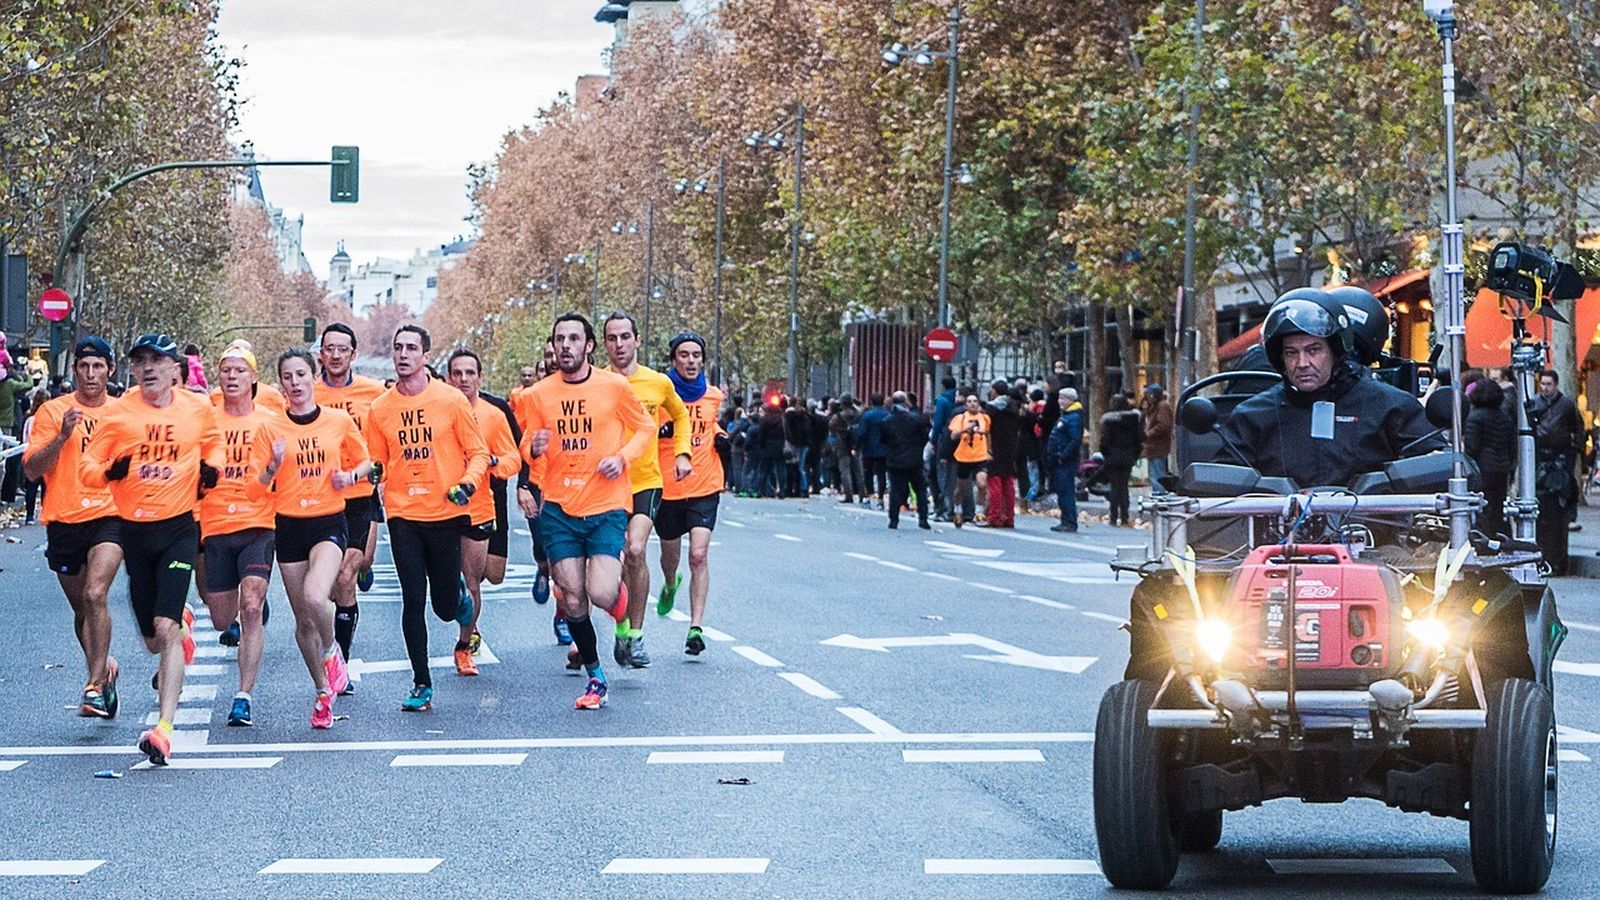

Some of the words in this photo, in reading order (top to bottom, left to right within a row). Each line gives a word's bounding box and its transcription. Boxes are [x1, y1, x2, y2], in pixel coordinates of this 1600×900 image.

[561, 399, 587, 416] WE
[400, 408, 426, 427] WE
[84, 419, 98, 435] W
[145, 424, 176, 442] WE
[557, 417, 592, 435] RUN
[225, 430, 252, 446] WE
[298, 437, 319, 451] WE
[398, 426, 432, 446] RUN
[561, 437, 588, 451] MAD
[139, 444, 180, 462] RUN
[296, 450, 325, 466] RUN
[403, 446, 430, 461] MAD
[300, 467, 322, 479] MAD
